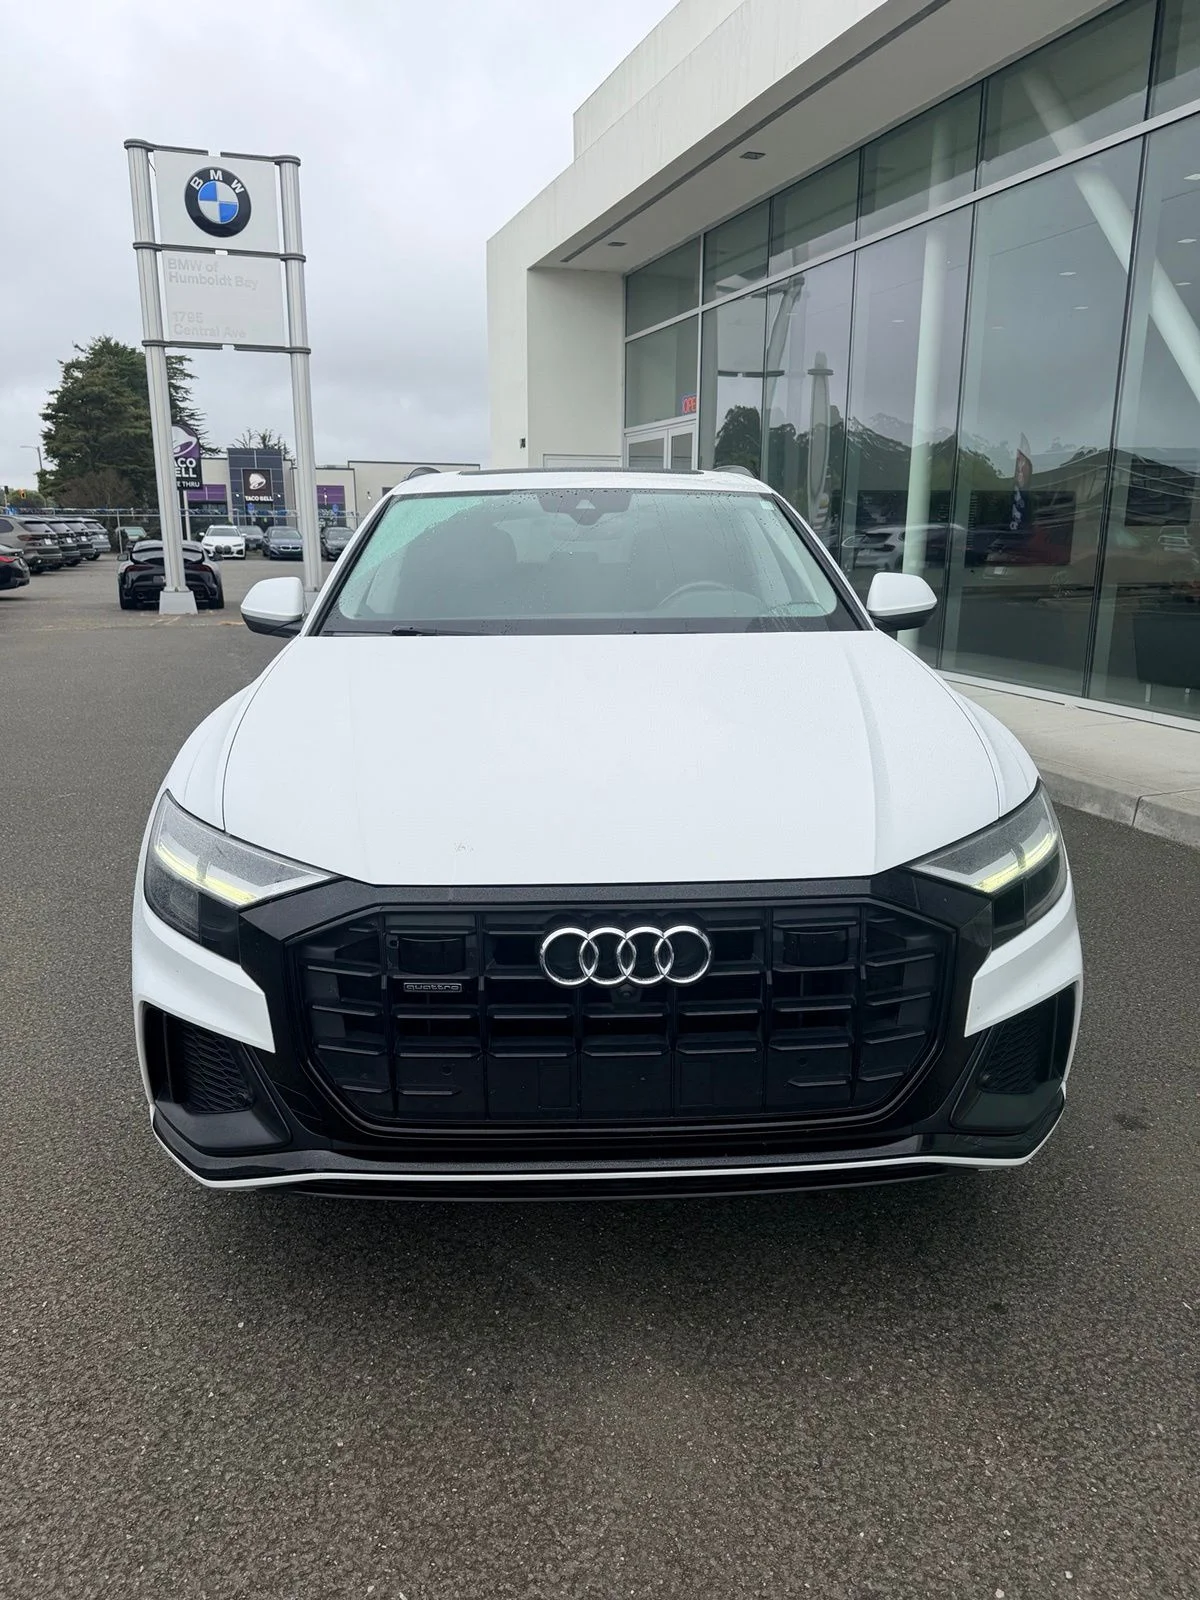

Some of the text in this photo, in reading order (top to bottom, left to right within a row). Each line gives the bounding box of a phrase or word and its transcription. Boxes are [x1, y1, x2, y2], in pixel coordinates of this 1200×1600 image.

[190, 169, 245, 194] BMW
[168, 258, 219, 273] BMW of
[168, 271, 232, 287] Humboldt
[174, 323, 220, 337] Central
[175, 467, 197, 478] ELL
